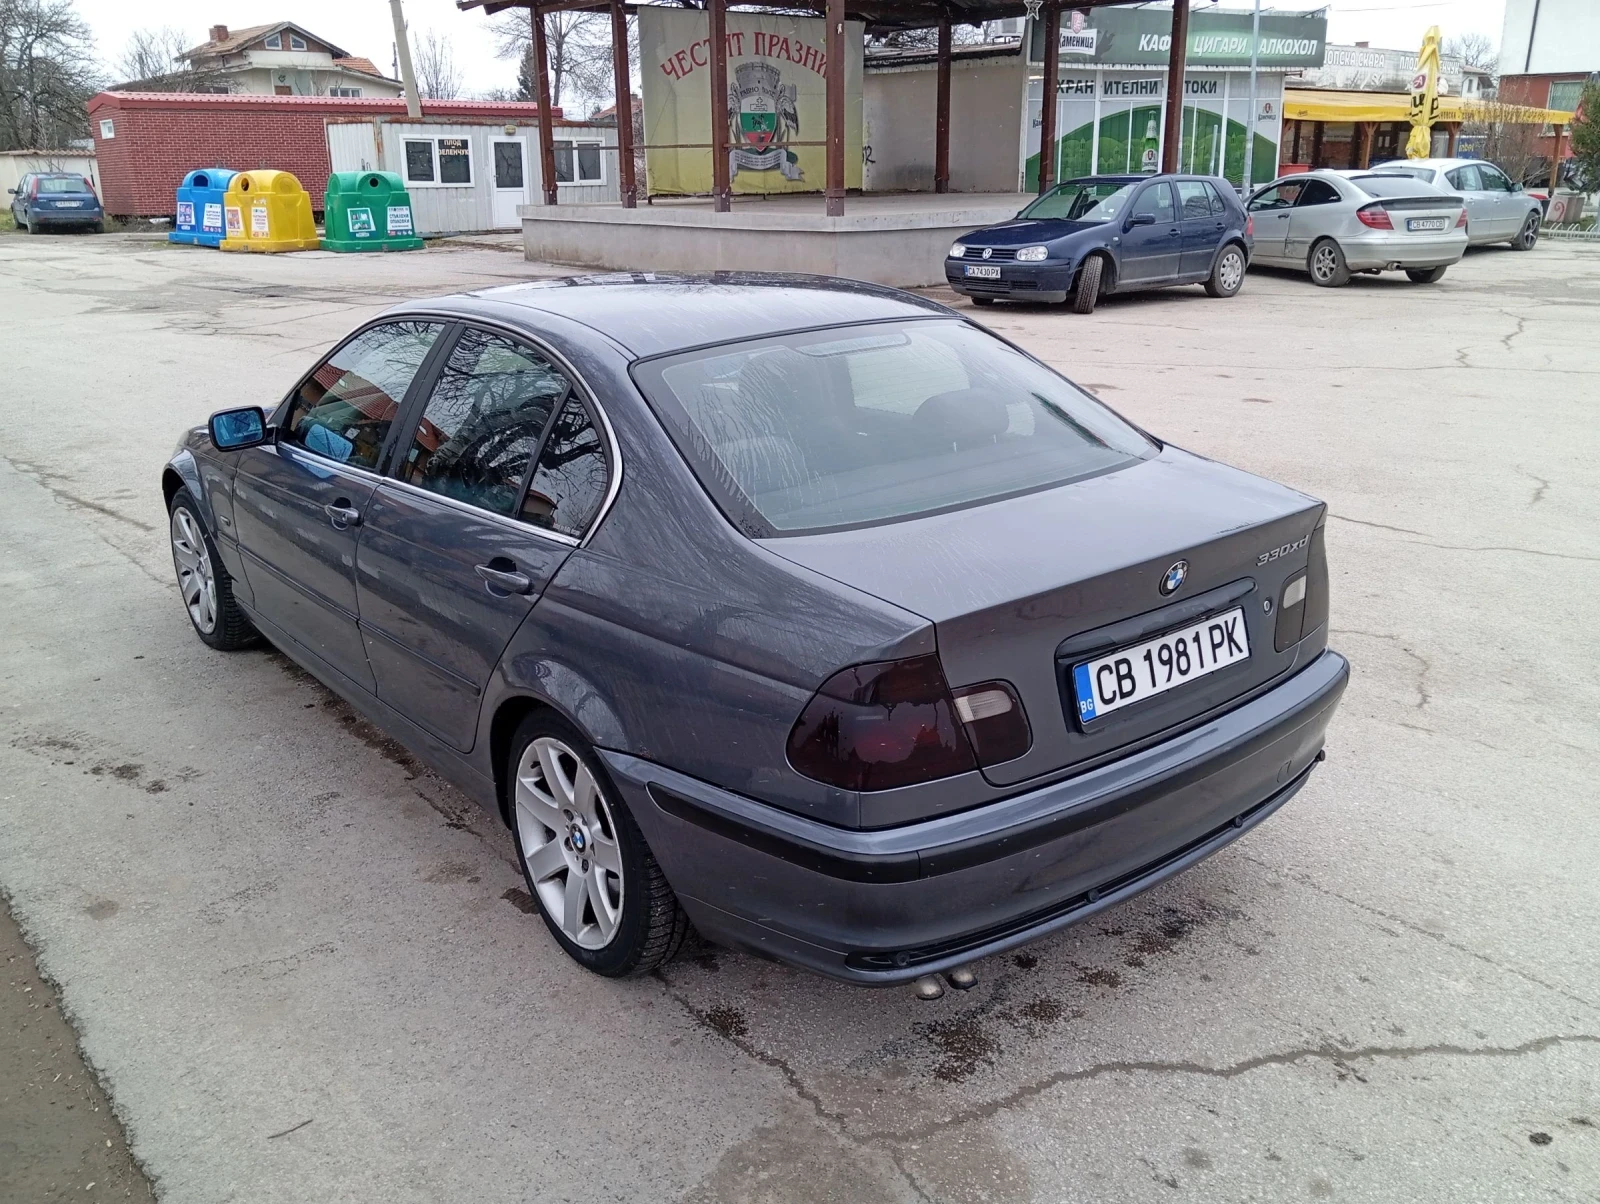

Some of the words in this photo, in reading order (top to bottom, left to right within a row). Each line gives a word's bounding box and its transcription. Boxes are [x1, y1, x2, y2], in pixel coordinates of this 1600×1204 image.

[753, 31, 827, 79] ПРАЗНИ
[1138, 33, 1172, 51] КАФ
[1258, 38, 1318, 56] АЛКОХОЛ
[1324, 50, 1356, 66] ОПСКА
[1358, 53, 1385, 67] СКАРА
[1184, 80, 1218, 94] ТОКИ
[1256, 534, 1309, 567] 330xd
[1096, 657, 1137, 706] CB
[1143, 631, 1205, 688] 1981
[1208, 616, 1244, 664] PK
[1080, 698, 1094, 714] BG
